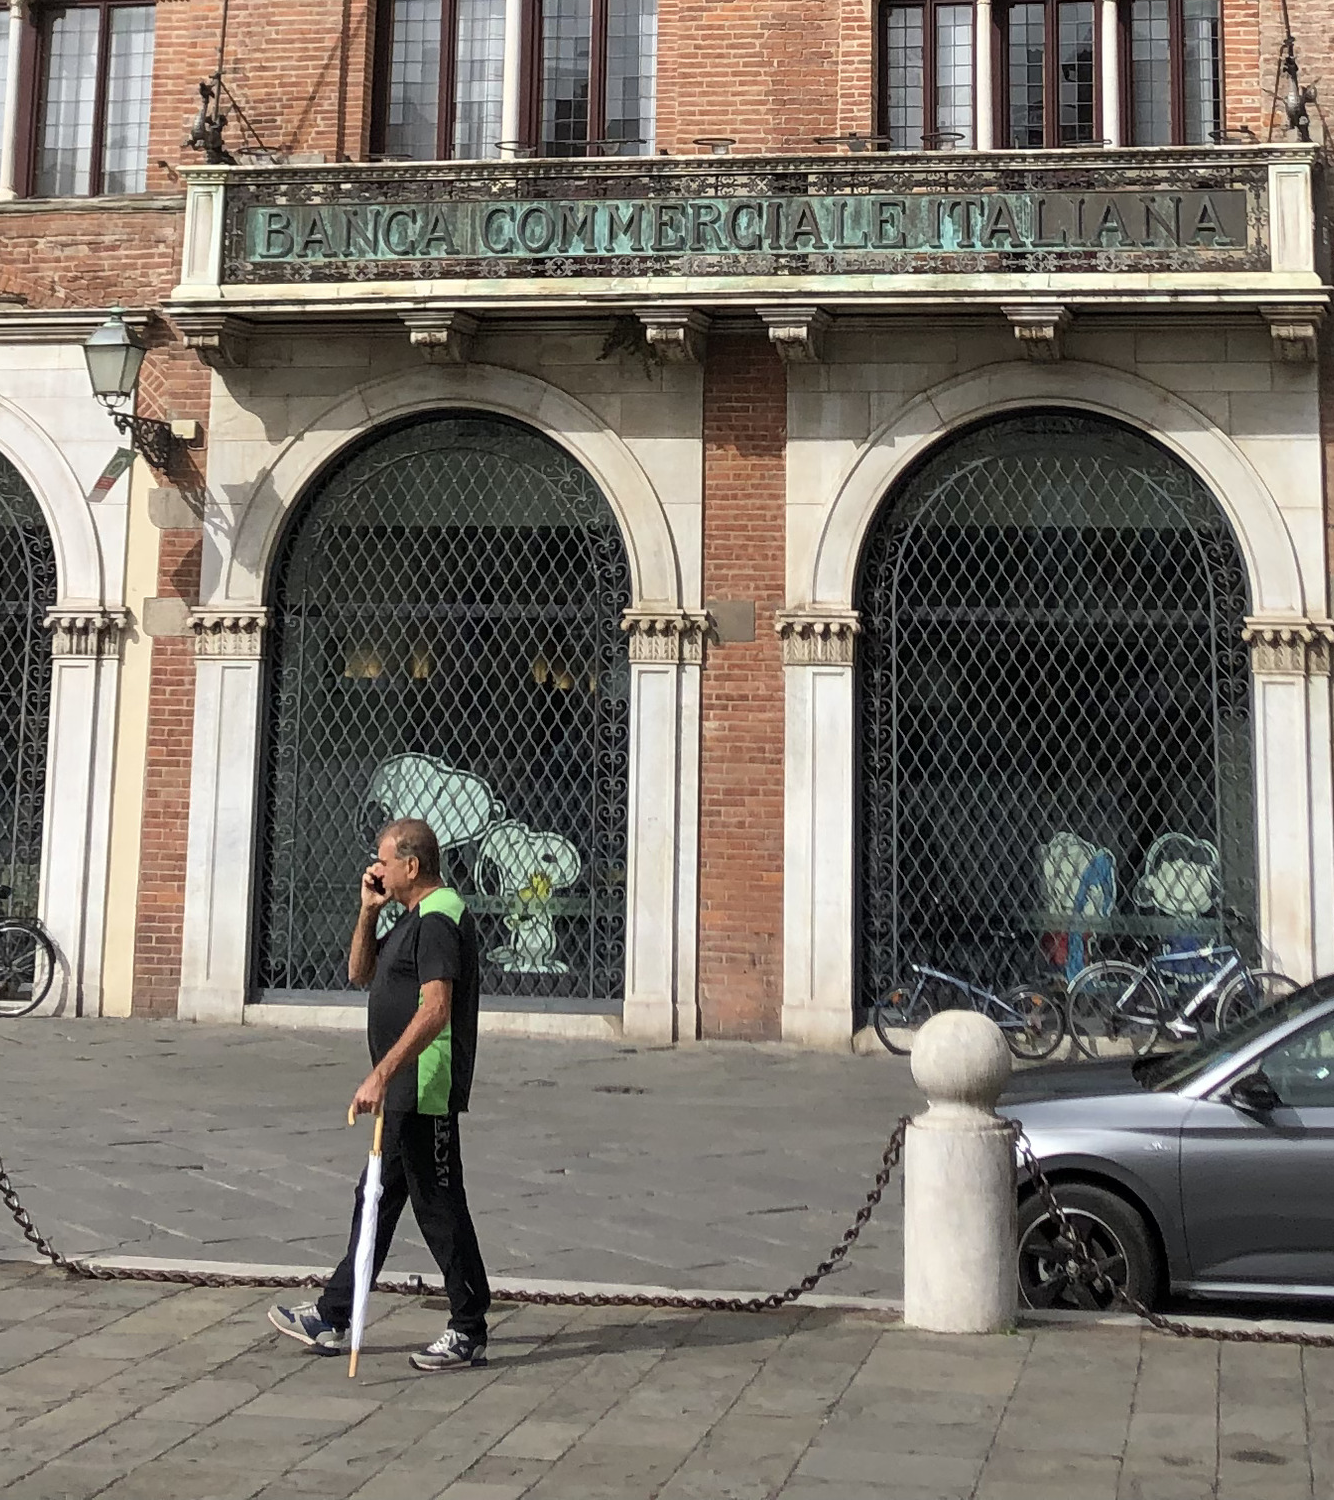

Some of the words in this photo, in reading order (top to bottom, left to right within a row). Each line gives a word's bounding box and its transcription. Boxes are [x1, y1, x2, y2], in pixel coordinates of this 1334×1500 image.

[258, 203, 461, 259] BANCA
[482, 198, 907, 256] COMMERCIALE
[930, 194, 1236, 250] ITALIANA
